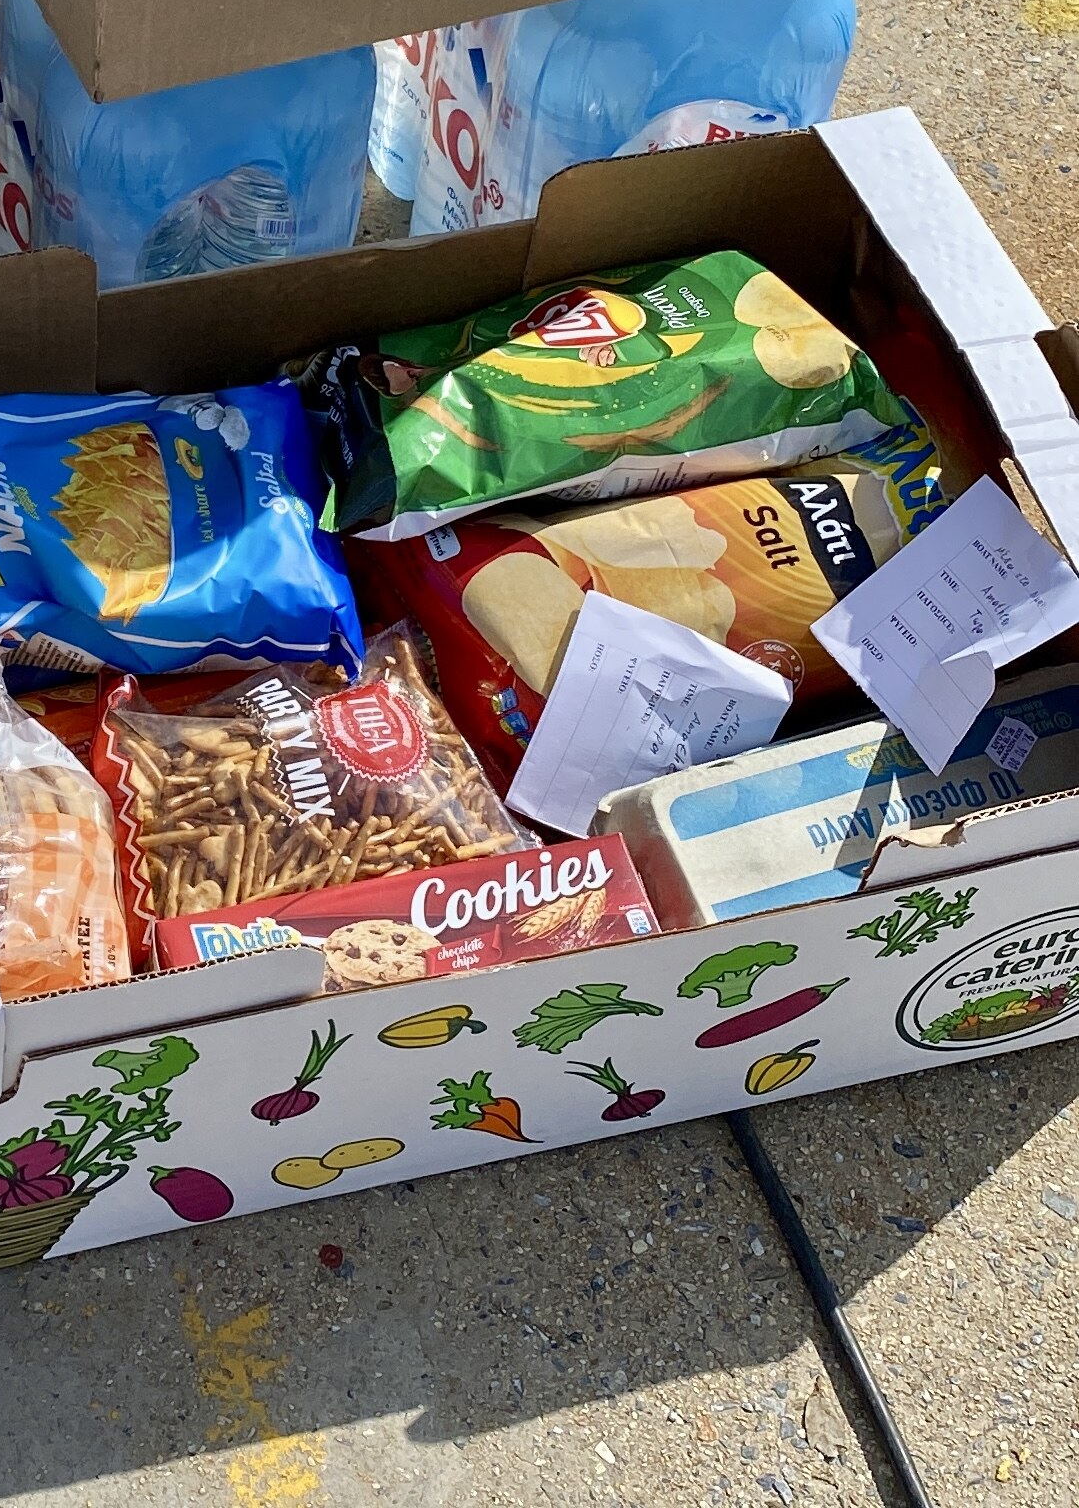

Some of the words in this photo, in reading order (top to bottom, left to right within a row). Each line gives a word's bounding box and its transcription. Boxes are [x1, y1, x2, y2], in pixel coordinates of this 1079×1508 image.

[678, 286, 712, 319] Oregano
[255, 451, 289, 516] Salted
[743, 504, 801, 571] Salt
[789, 479, 858, 567] Αλάτι
[972, 538, 993, 562] BOAT
[939, 569, 961, 595] TIME:
[888, 613, 920, 650] ΨΥΓΕΙΟ:
[860, 635, 886, 665] ΠΟΣΟ:
[252, 676, 315, 753] PARTY
[719, 697, 738, 723] BOAT
[283, 753, 336, 825] MIX
[988, 771, 1025, 802] 10
[807, 807, 875, 854] Αυγά
[411, 847, 614, 936] Cookies
[436, 938, 485, 965] chocolate
[451, 952, 481, 971] chips
[959, 981, 1005, 999] FRESH
